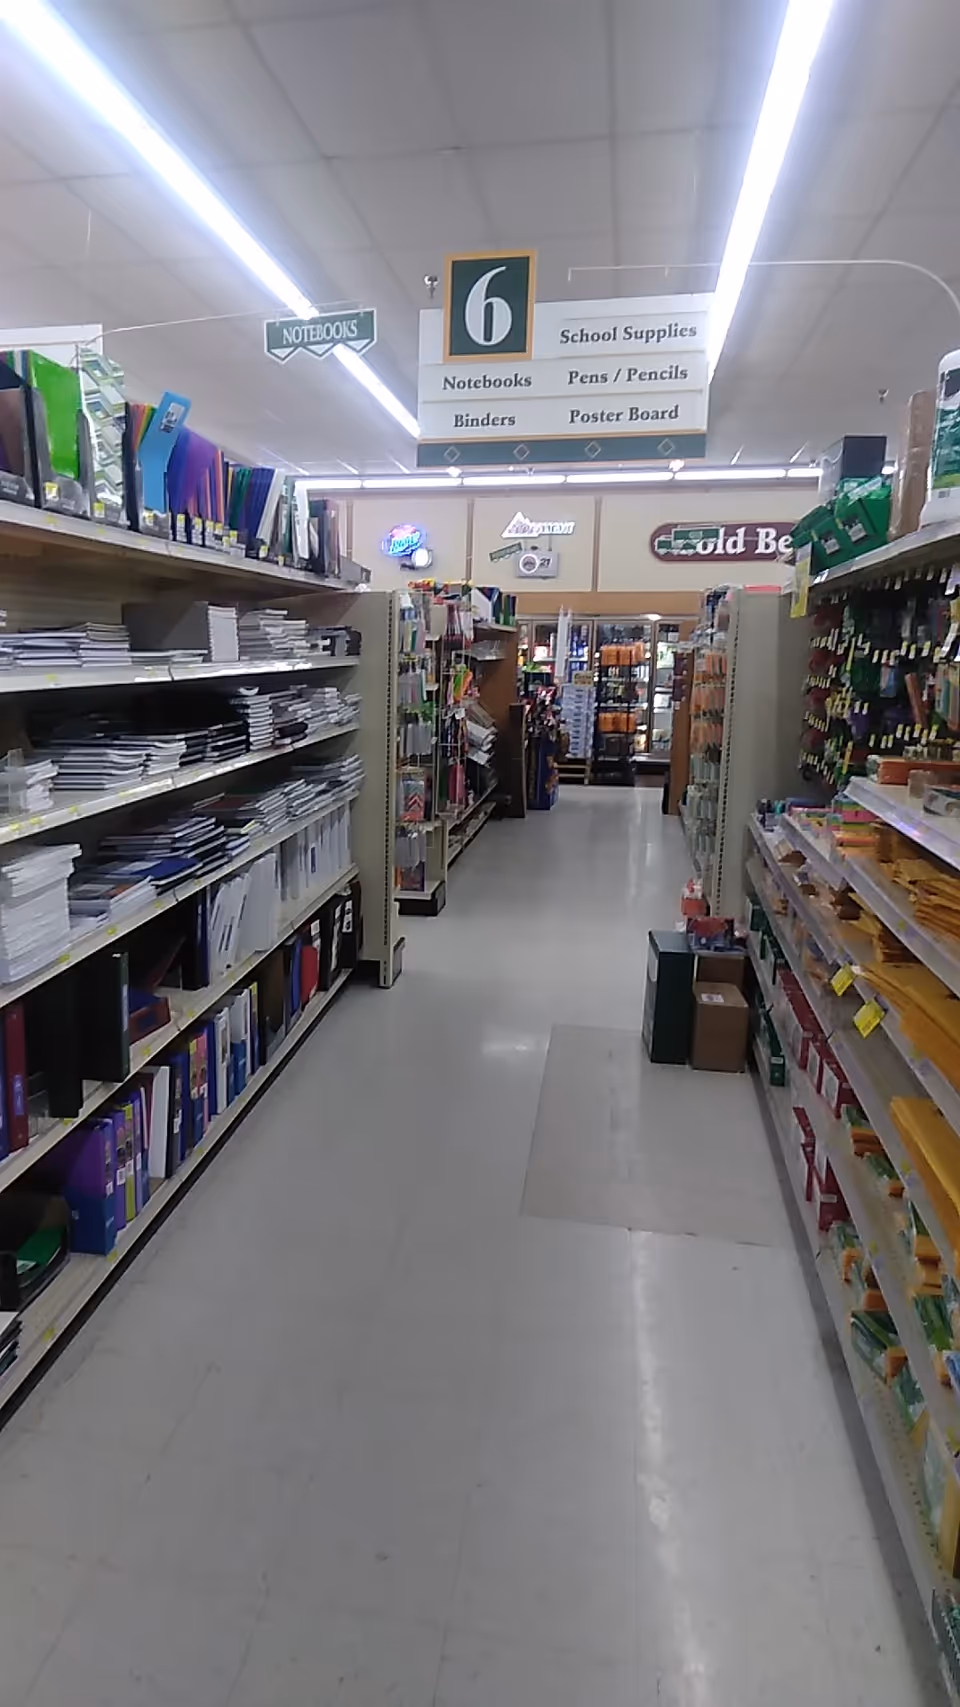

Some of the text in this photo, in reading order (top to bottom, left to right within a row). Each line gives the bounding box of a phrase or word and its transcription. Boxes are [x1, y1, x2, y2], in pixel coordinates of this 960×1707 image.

[465, 266, 513, 346] 6
[282, 319, 358, 344] NOTEBOOKS
[560, 322, 697, 344] School Supplies
[442, 373, 532, 390] Notebooks
[568, 365, 688, 385] Pens / Pencils
[453, 412, 516, 427] Binders
[569, 404, 679, 424] Poster Board
[695, 526, 746, 555] old
[755, 527, 794, 555] Be
